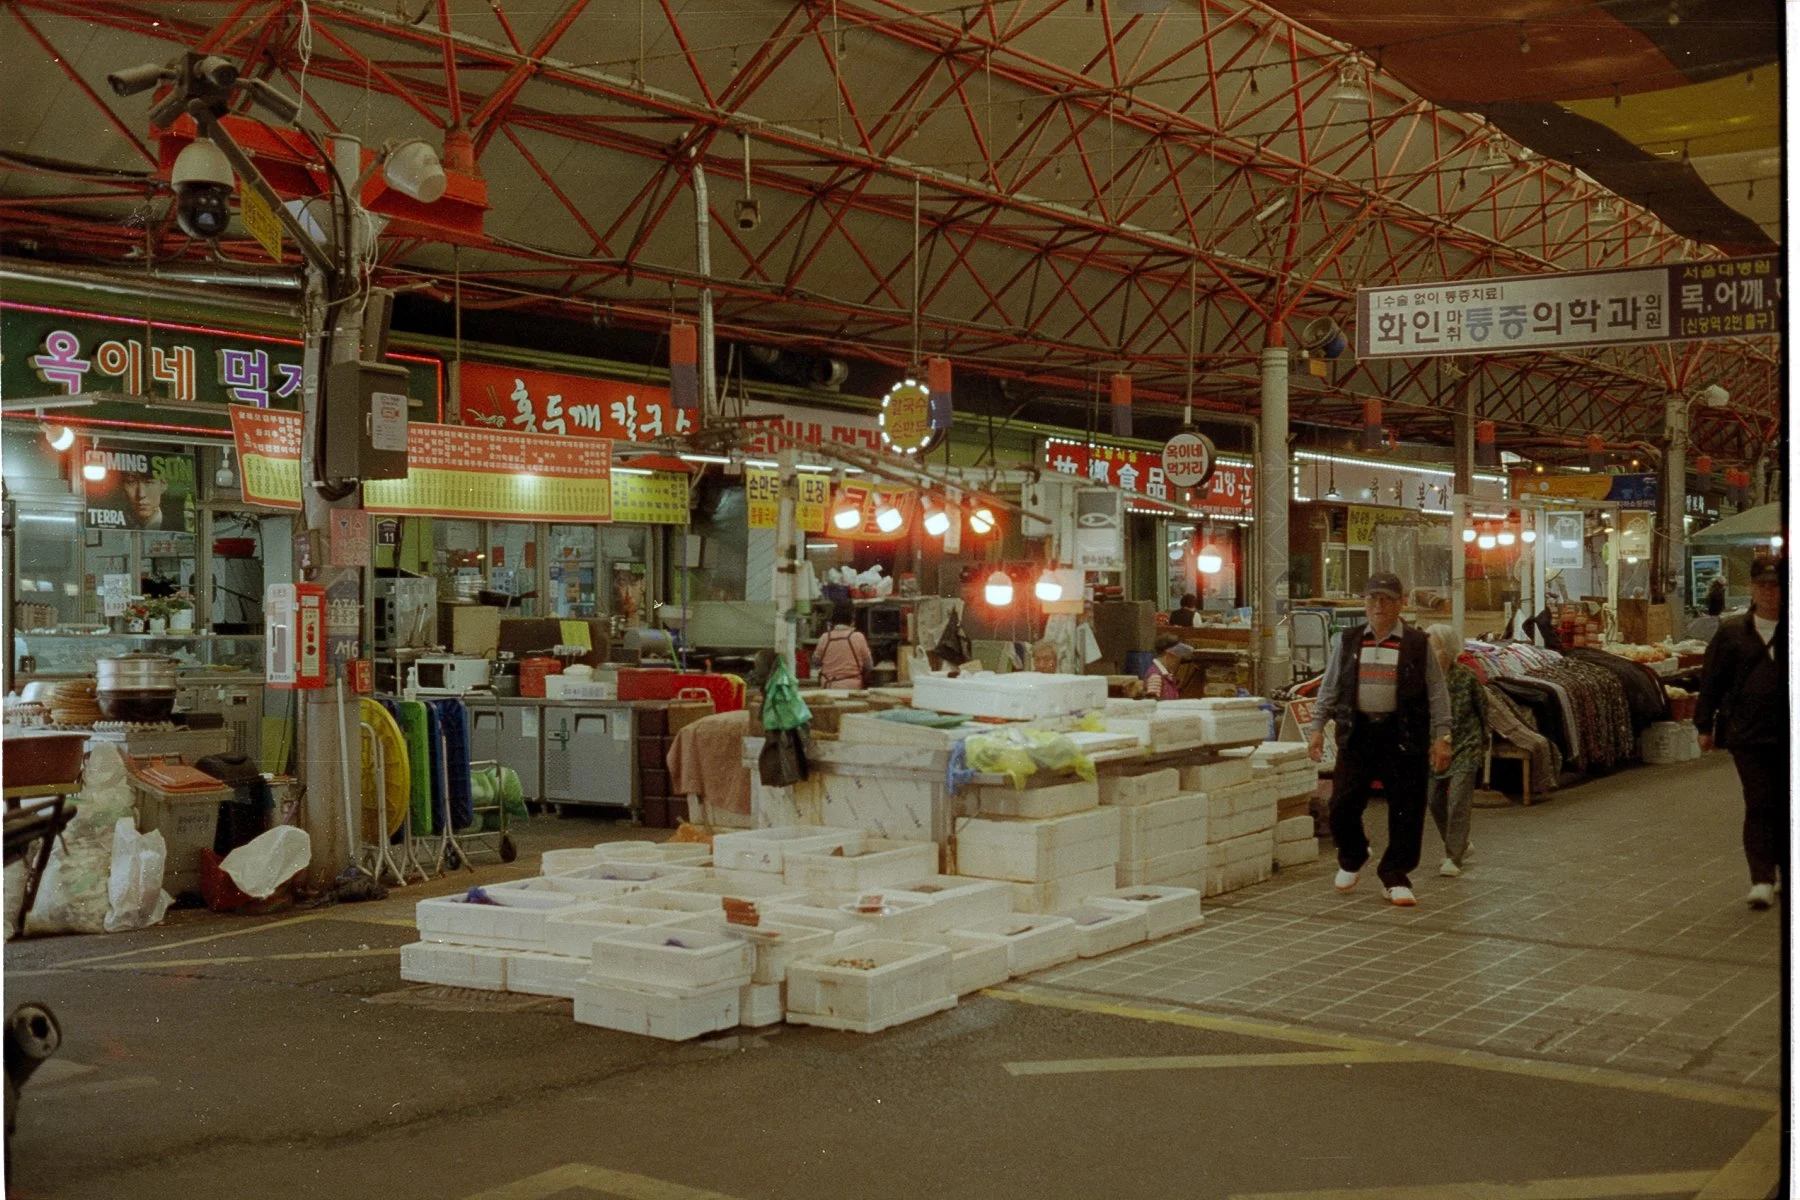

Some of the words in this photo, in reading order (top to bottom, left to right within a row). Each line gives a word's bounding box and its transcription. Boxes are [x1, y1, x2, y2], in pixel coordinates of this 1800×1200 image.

[1683, 260, 1770, 279] 서울대병원
[1384, 294, 1409, 308] 수술
[1414, 291, 1440, 306] 없이
[1445, 287, 1499, 304] 통증치료
[1724, 313, 1743, 332] 2번
[34, 330, 196, 401] 옥이네
[1166, 443, 1203, 458] 옥이네
[1166, 461, 1203, 477] 먹거리
[806, 478, 825, 504] 포장
[87, 508, 127, 527] TERRA
[384, 532, 395, 543] 11
